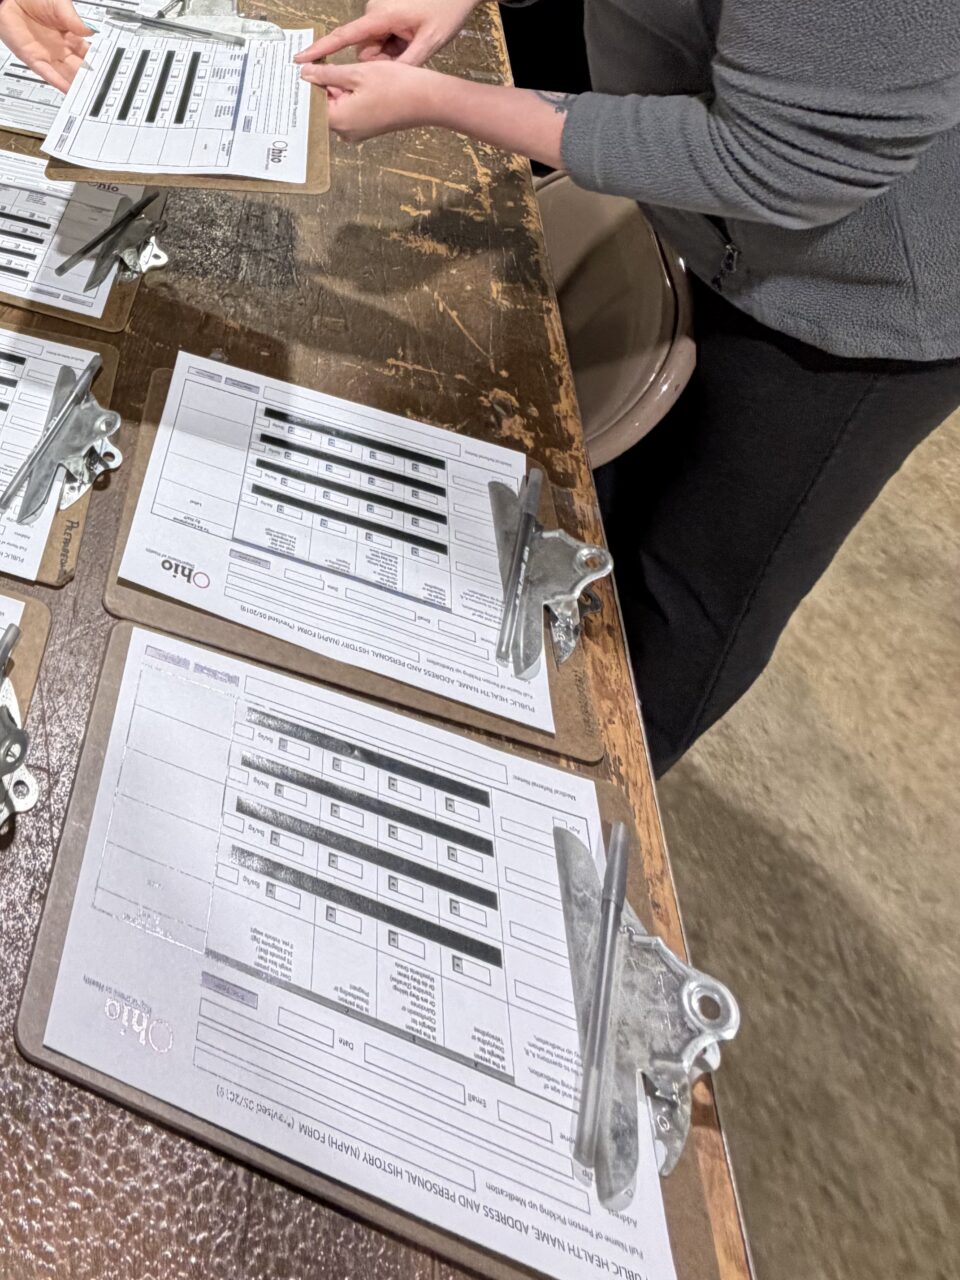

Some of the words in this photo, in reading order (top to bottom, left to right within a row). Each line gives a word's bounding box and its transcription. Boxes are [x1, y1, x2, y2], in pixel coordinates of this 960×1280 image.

[271, 140, 288, 163] Ohio
[160, 559, 211, 590] Ohio
[104, 998, 173, 1054] Ohio
[338, 1035, 353, 1050] Date
[466, 1091, 486, 1108] Email
[298, 1120, 325, 1145] FORM
[327, 1133, 360, 1160] (NAPH)
[361, 1149, 402, 1179] HISTORY
[404, 1169, 456, 1204] PERSONAL
[484, 1180, 527, 1208] Medication
[457, 1191, 480, 1215] AND
[527, 1198, 538, 1212] up
[538, 1201, 567, 1226] Picking
[482, 1202, 529, 1236] ADDRESS
[567, 1216, 594, 1238] Person
[530, 1223, 565, 1252] NAME,
[593, 1227, 603, 1243] of
[603, 1232, 628, 1253] Name
[566, 1239, 609, 1271] HEALTH
[627, 1242, 644, 1260] Full
[610, 1258, 649, 1280] UBLIC
